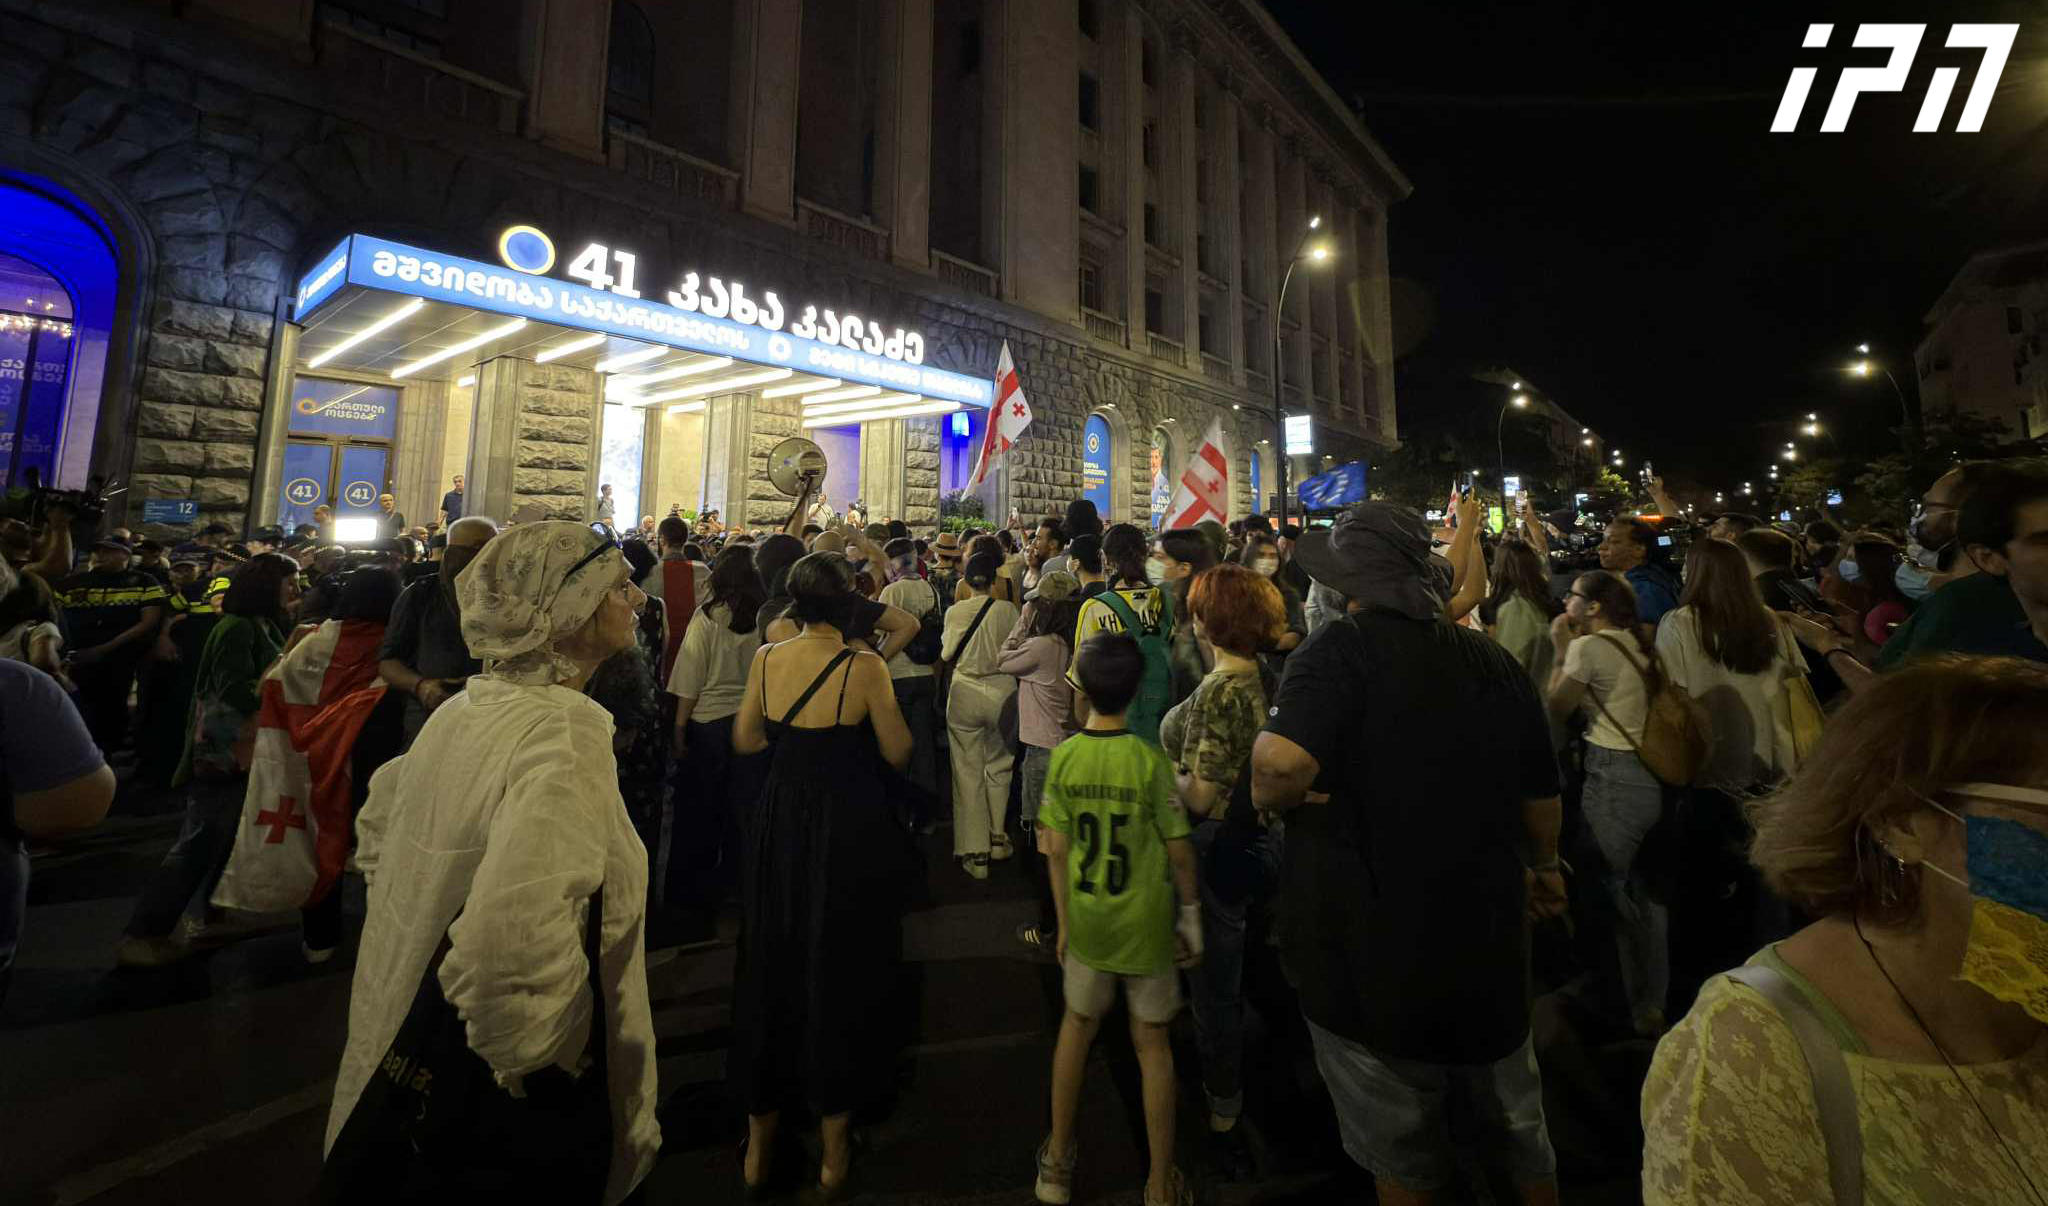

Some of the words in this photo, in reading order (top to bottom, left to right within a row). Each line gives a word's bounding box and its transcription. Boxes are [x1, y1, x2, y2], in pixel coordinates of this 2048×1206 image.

[372, 250, 554, 310] მშვიდობა
[568, 242, 641, 299] 41
[667, 270, 785, 331] კახა
[790, 304, 925, 365] კალაძე
[178, 502, 193, 514] 12
[292, 485, 313, 498] 41
[351, 488, 370, 500] 41
[1074, 811, 1133, 896] 25
